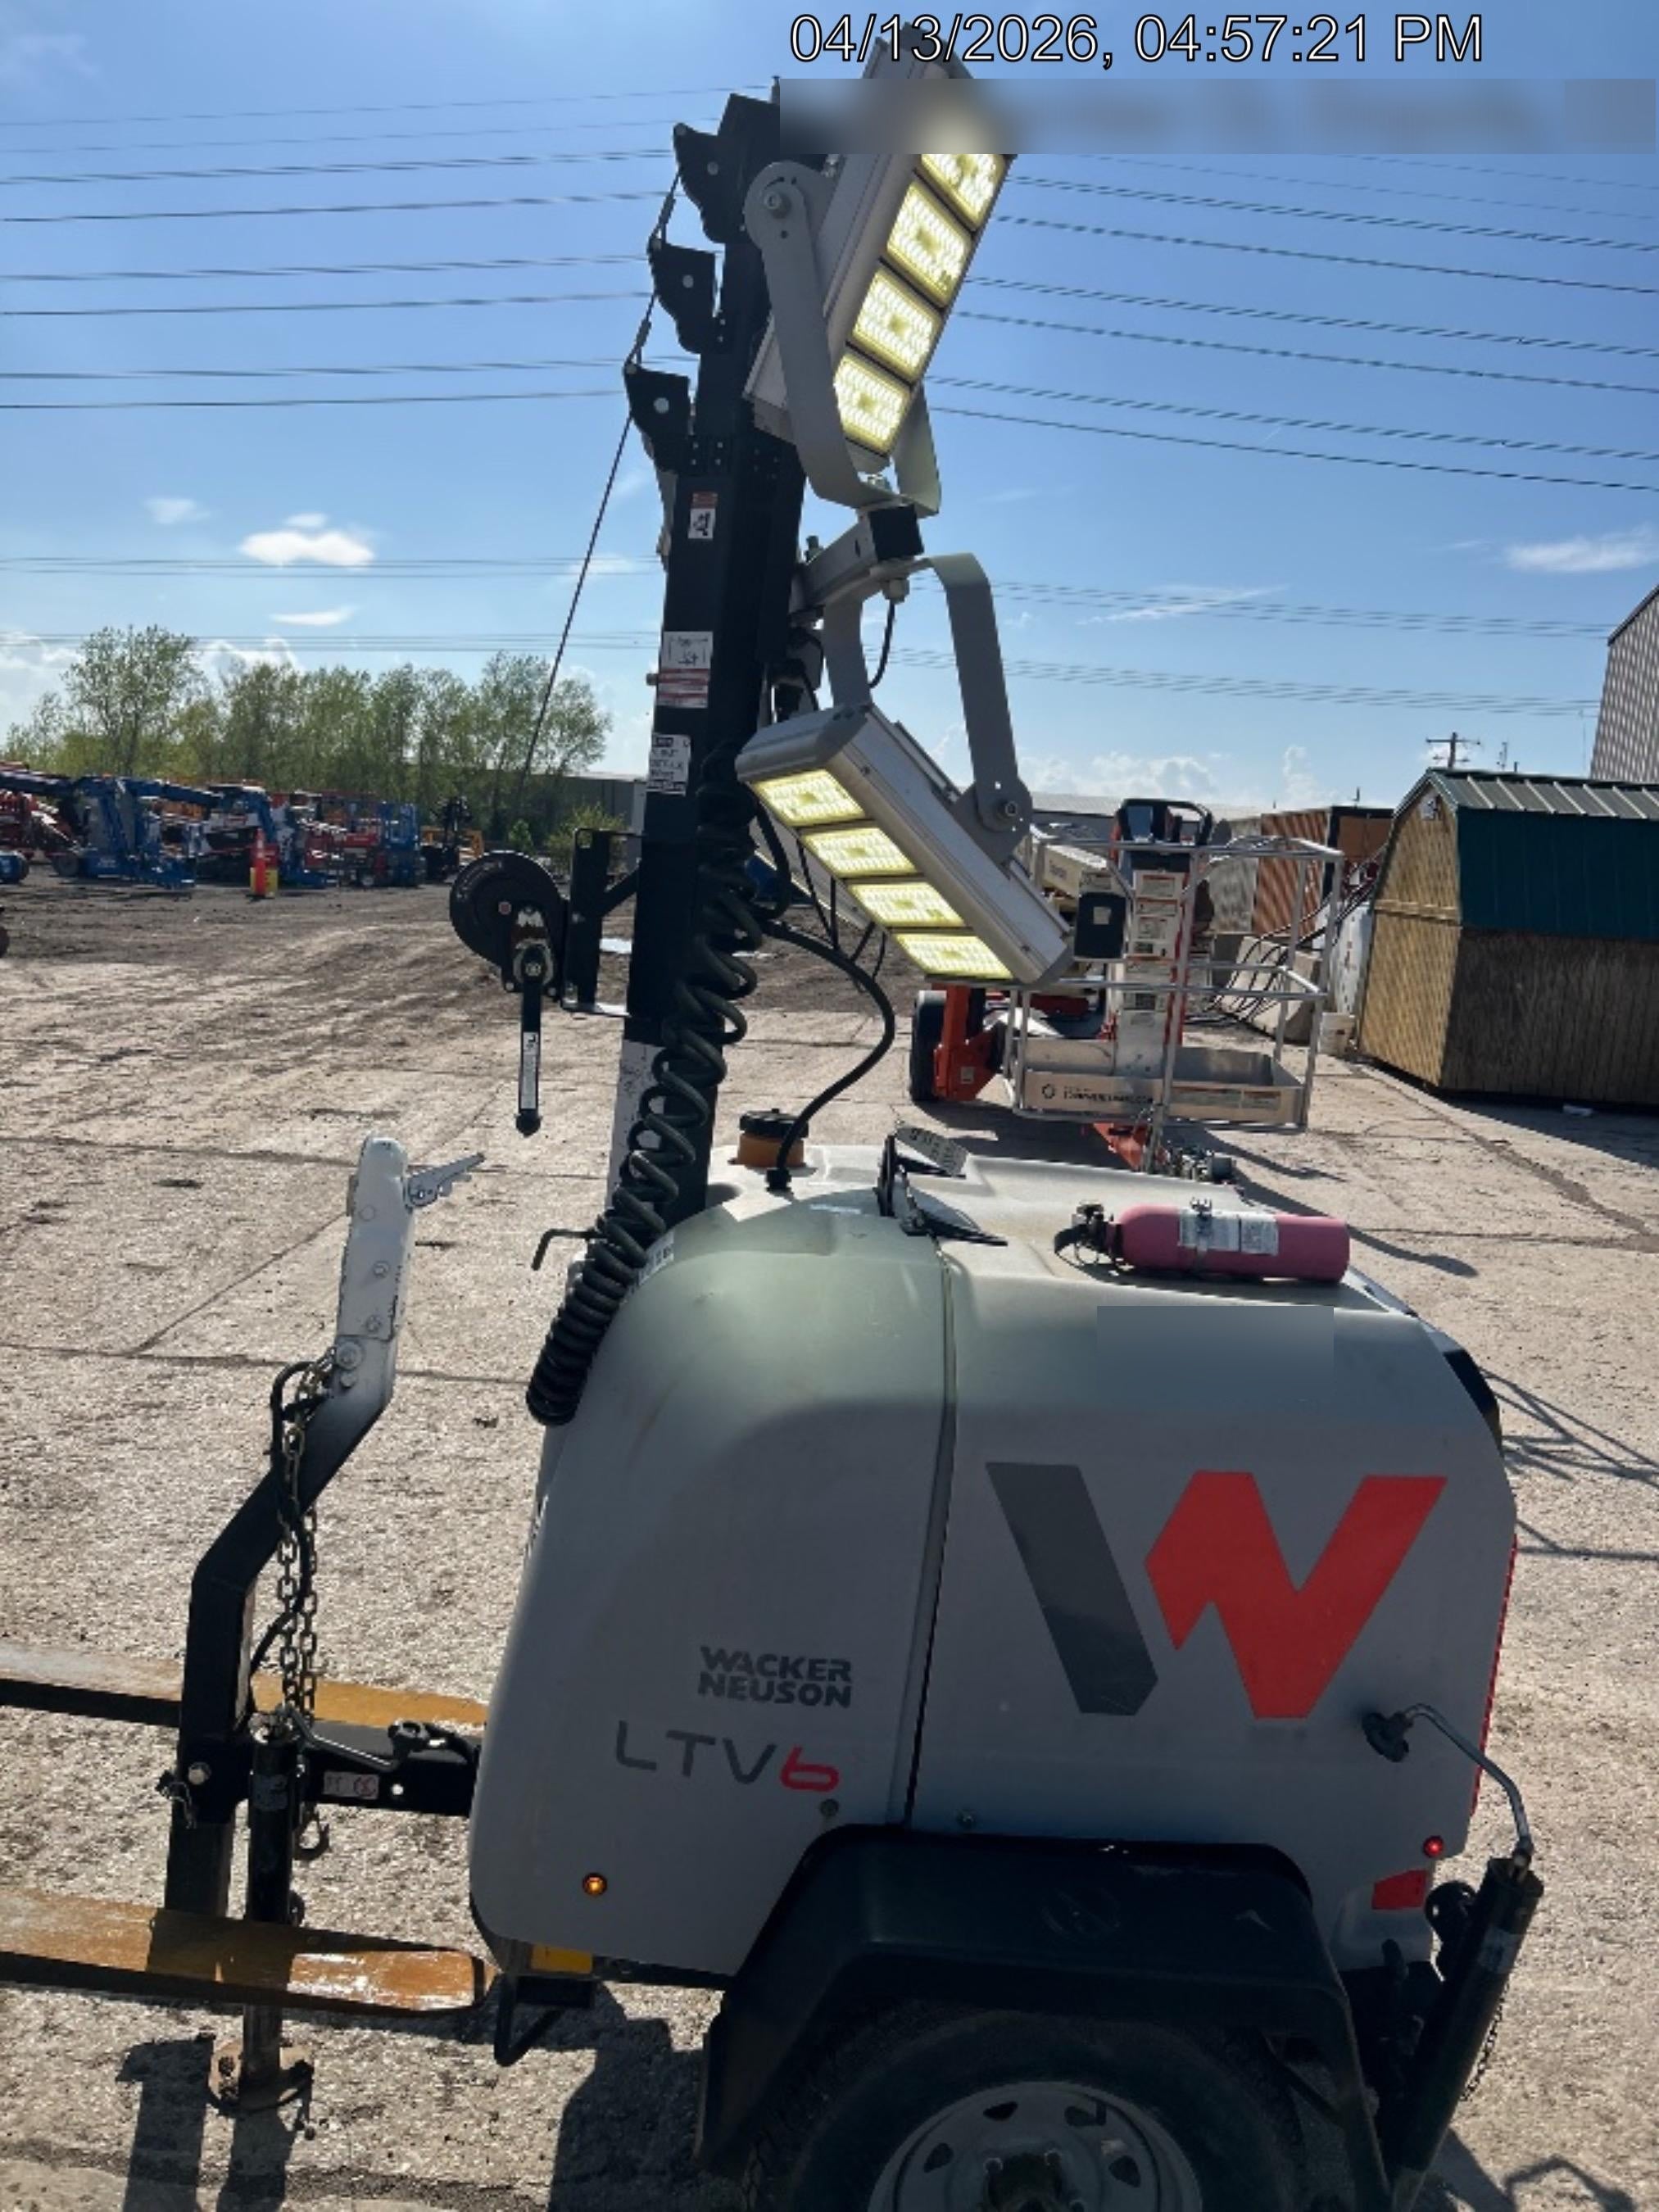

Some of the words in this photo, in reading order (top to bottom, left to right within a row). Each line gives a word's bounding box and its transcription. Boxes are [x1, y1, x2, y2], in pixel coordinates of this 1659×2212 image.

[700, 1645, 852, 1684] WACKER
[697, 1670, 852, 1709] NEUSON
[615, 1720, 841, 1793] LTV6
